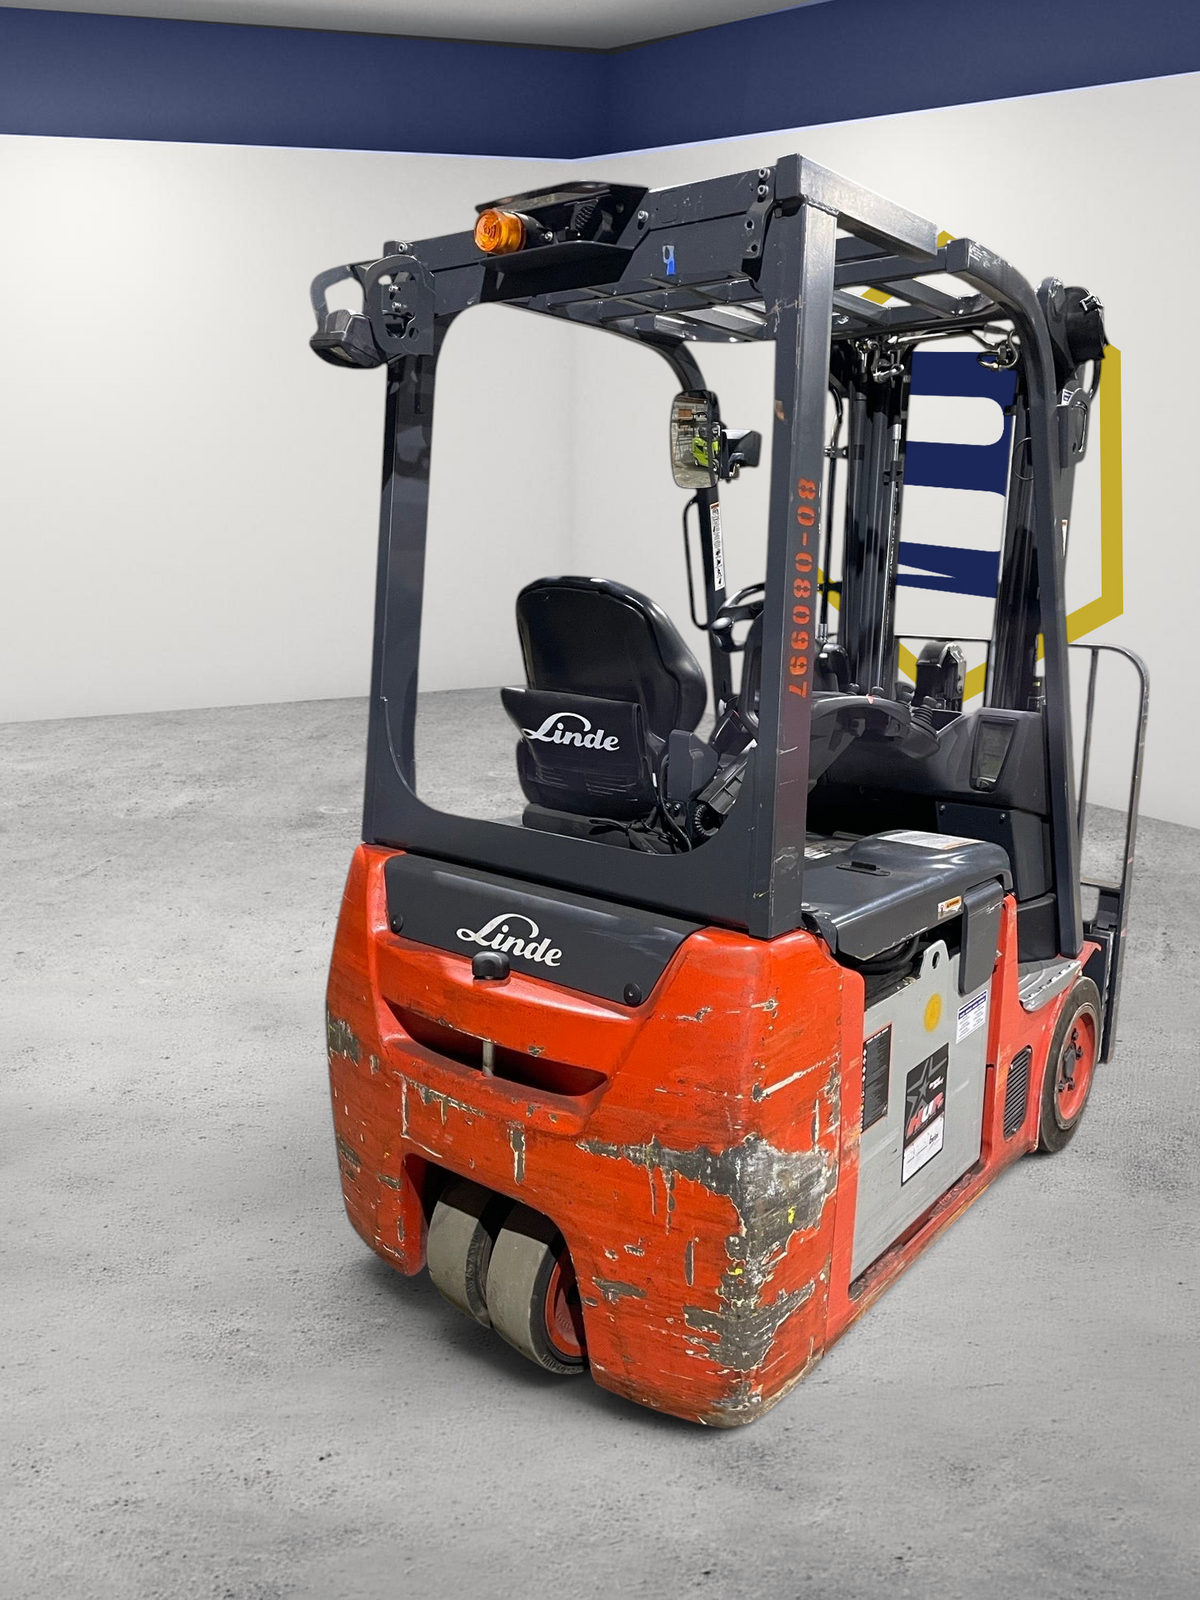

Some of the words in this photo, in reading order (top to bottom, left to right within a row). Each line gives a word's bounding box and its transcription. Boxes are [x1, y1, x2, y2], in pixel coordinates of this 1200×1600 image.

[789, 478, 817, 699] 80-080997
[521, 712, 620, 751] Linde
[456, 913, 562, 967] Linde
